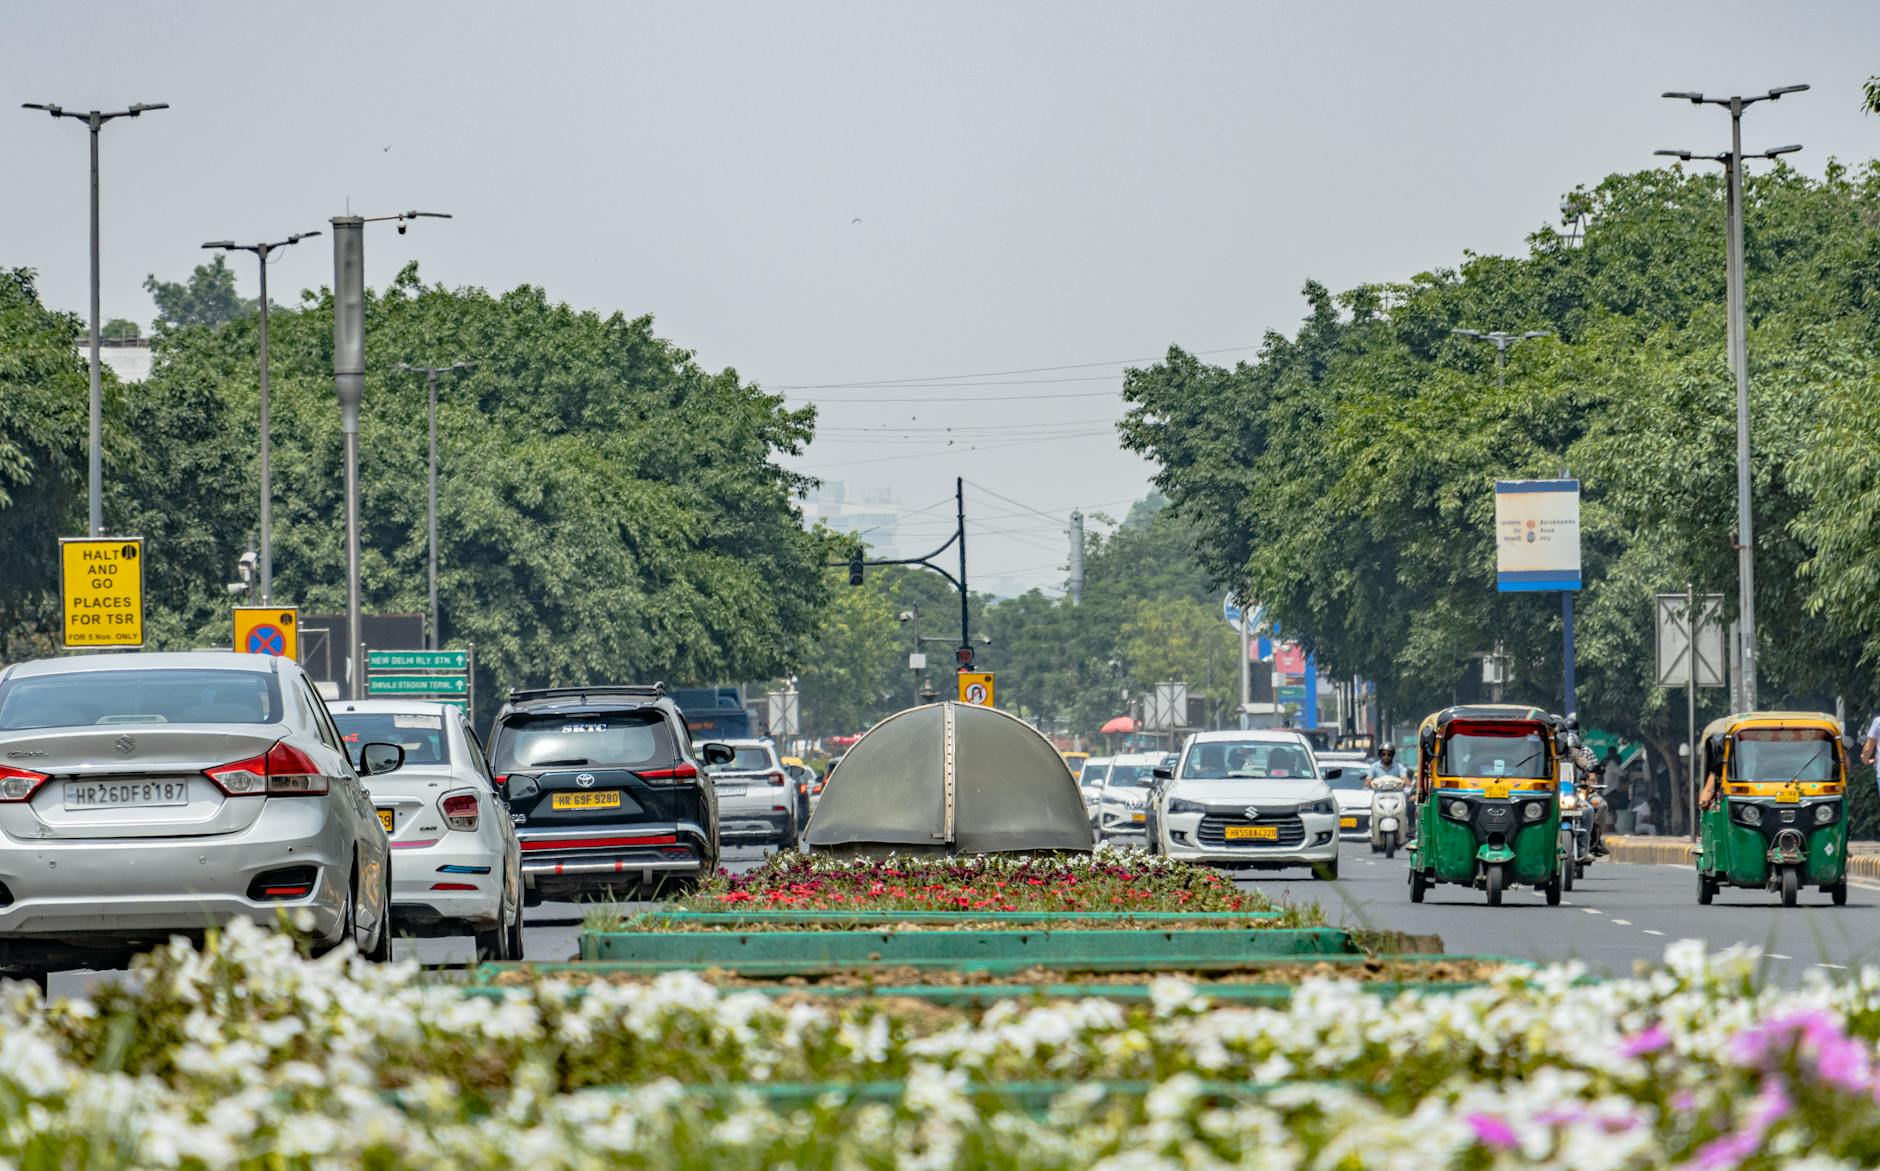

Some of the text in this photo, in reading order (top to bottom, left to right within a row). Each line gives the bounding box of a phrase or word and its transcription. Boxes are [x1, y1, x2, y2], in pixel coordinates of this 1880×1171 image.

[83, 550, 119, 560] HALT
[88, 564, 117, 575] AND
[92, 578, 113, 589] GO
[74, 597, 132, 608] PLACES
[71, 613, 134, 625] FOR TSR
[115, 632, 138, 640] ONLY
[371, 656, 390, 664] NEW
[391, 656, 414, 664] DELHI
[398, 681, 428, 689] STADIUM
[76, 783, 184, 804] HR26DF8187
[559, 795, 571, 806] HR
